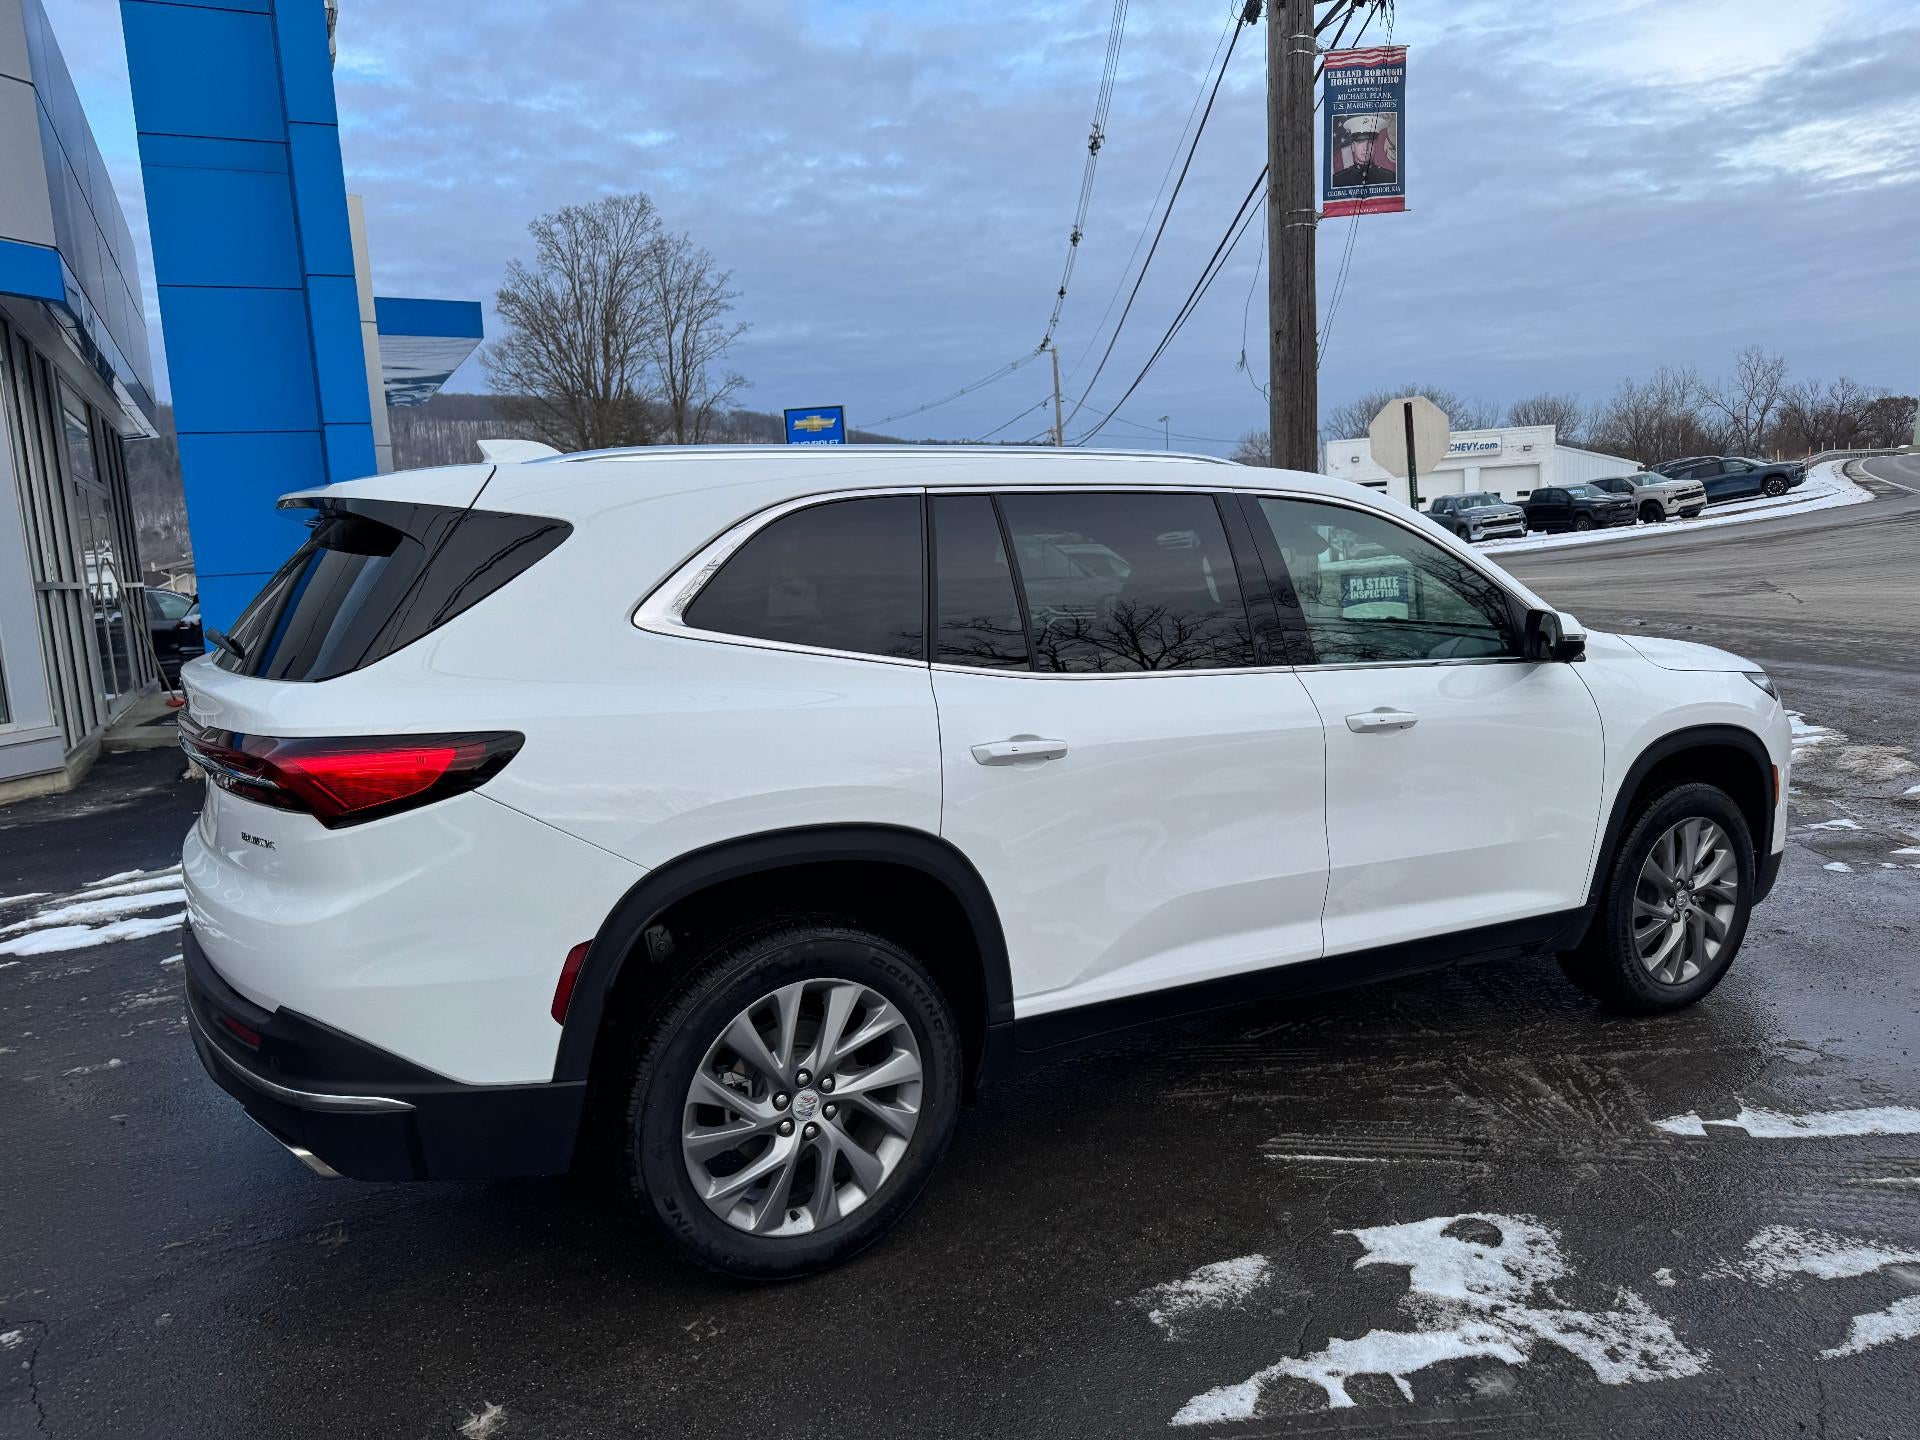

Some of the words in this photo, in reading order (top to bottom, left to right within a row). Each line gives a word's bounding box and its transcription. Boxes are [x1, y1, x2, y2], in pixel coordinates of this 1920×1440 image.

[1327, 69, 1361, 79] ELKLAND
[1364, 68, 1403, 77] BOROUGH
[1331, 77, 1375, 86] HOMETOWN
[1377, 76, 1399, 84] HERO
[1337, 93, 1368, 101] MICHAEL
[1346, 101, 1373, 109] MARINE
[1449, 442, 1498, 452] CHEVY.com
[1349, 578, 1364, 591] PA
[1365, 576, 1399, 589] STATE
[1350, 588, 1400, 600] INSPECTION
